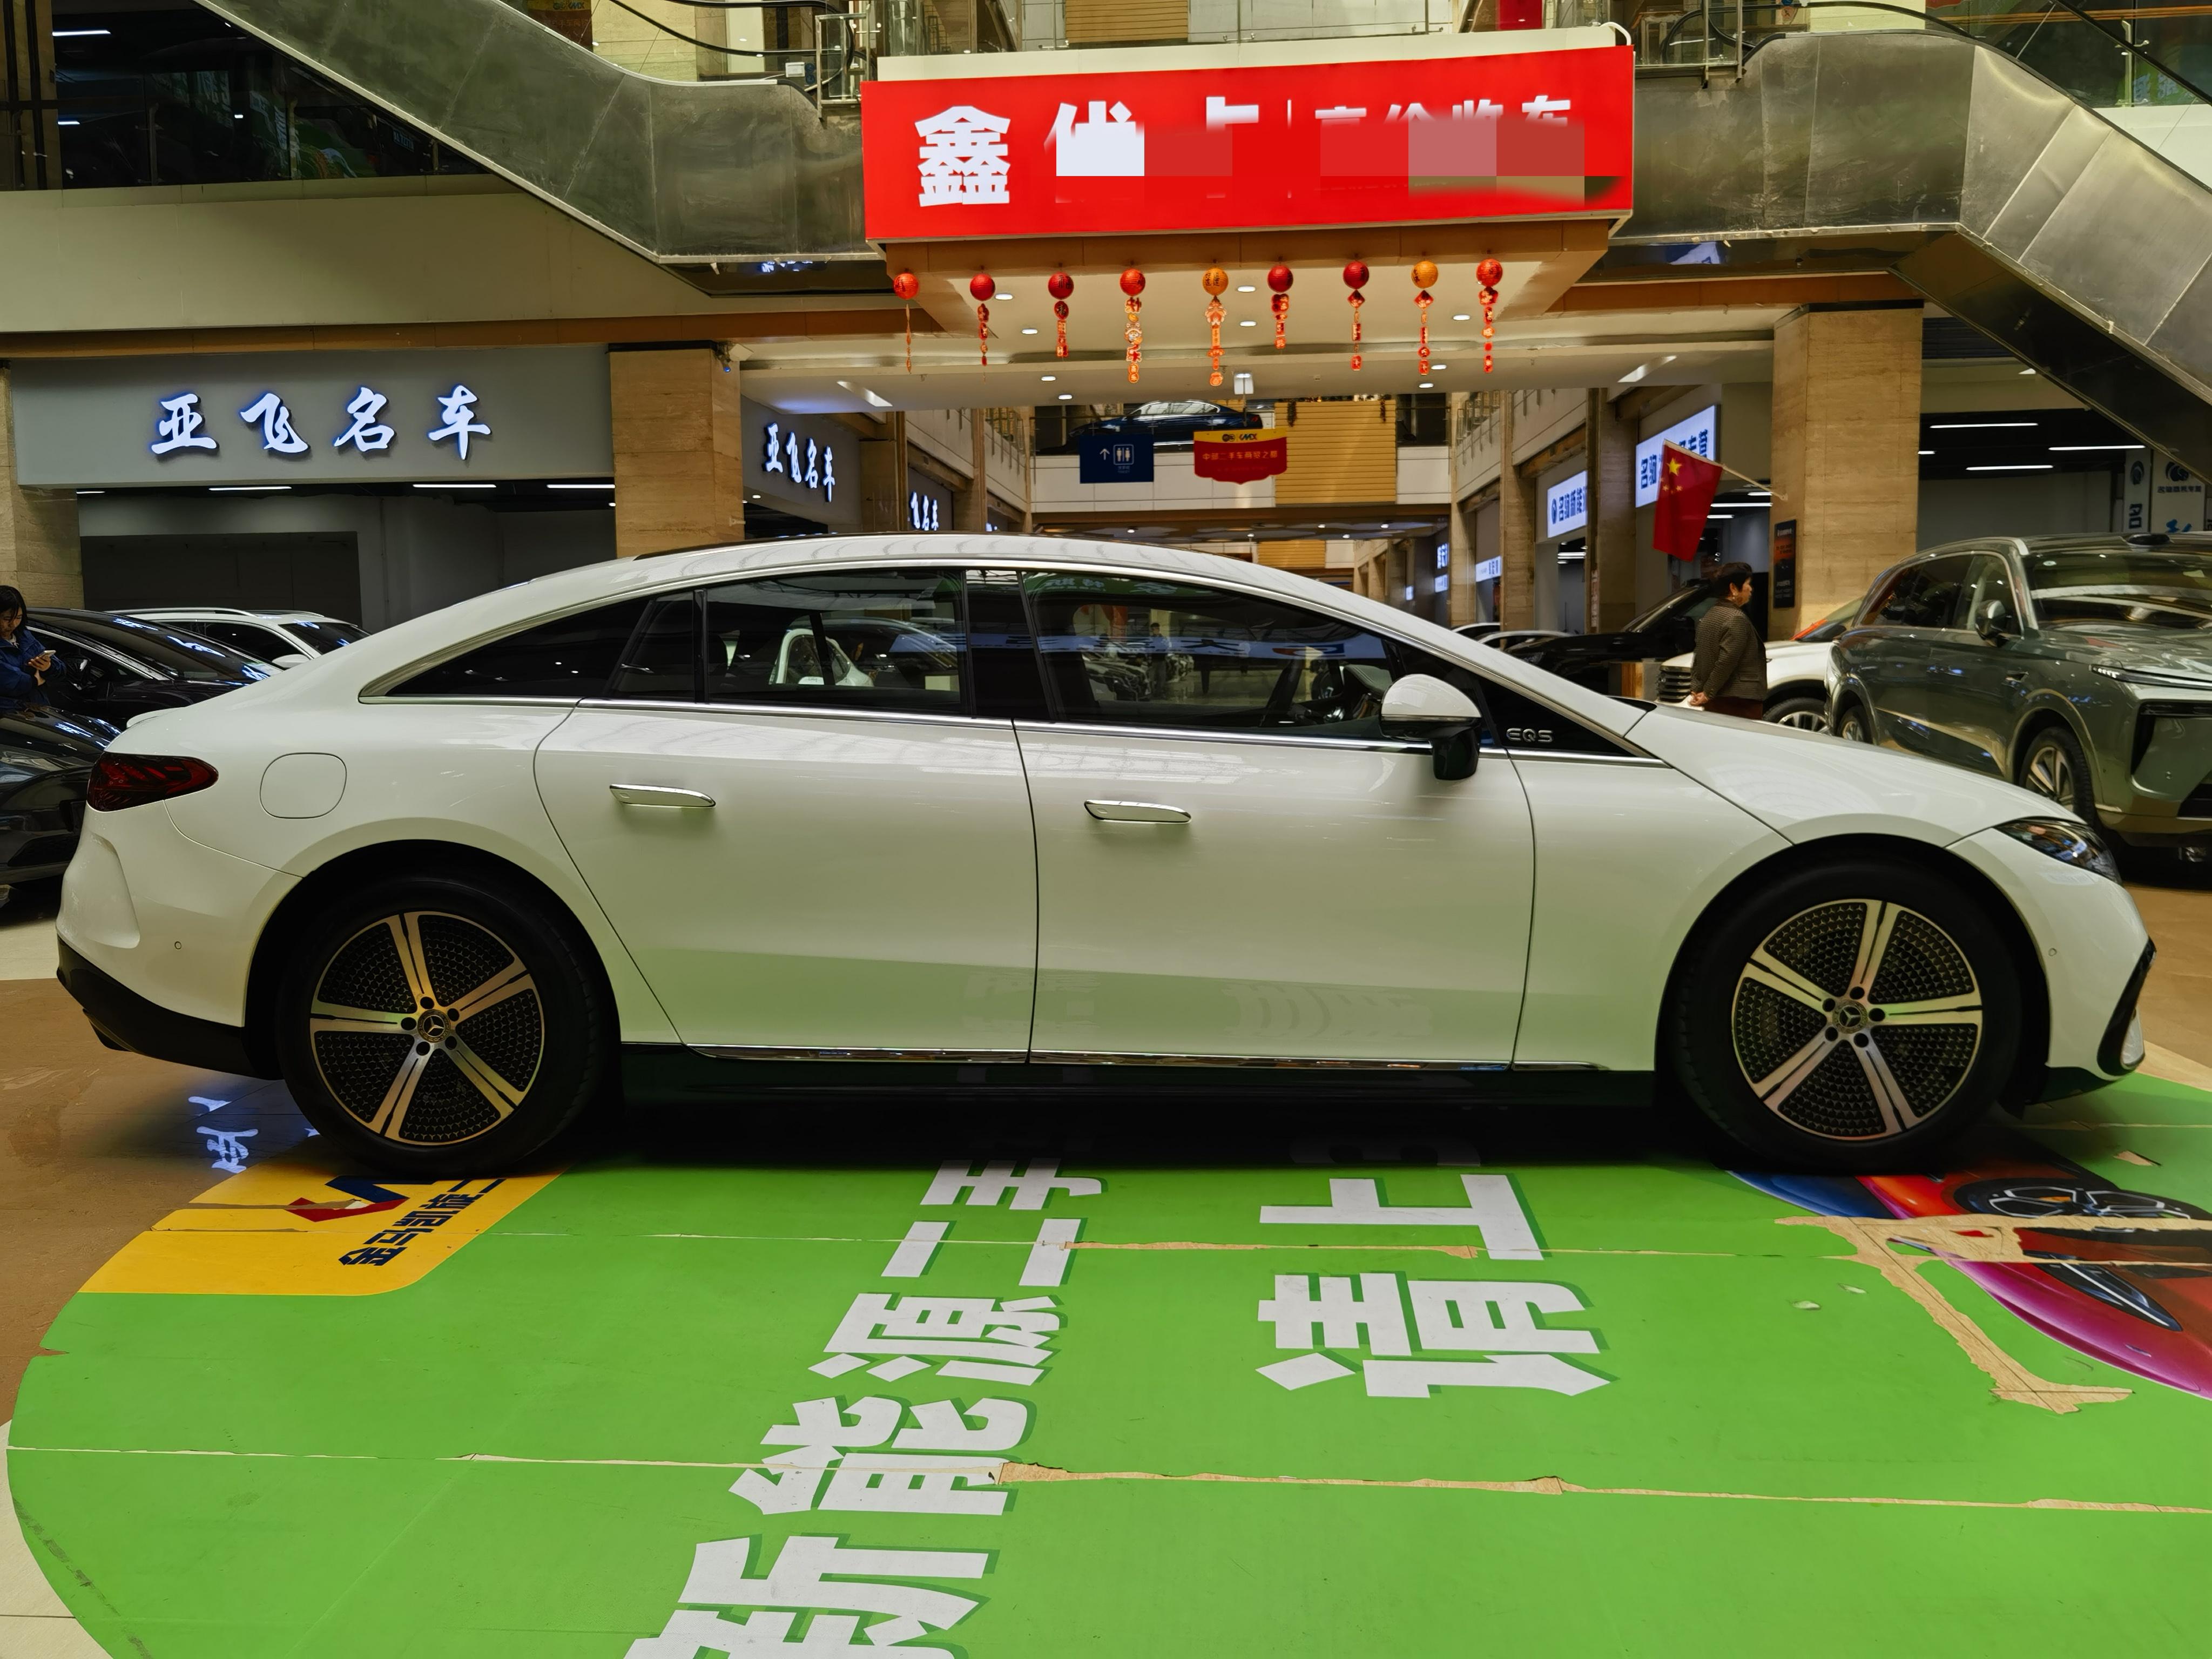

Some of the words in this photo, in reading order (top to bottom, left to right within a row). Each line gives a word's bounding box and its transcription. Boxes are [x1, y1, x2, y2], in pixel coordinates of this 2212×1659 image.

[151, 384, 491, 461] 亚飞名车
[765, 422, 835, 502] 亚飞名车
[1506, 727, 1554, 744] EQS
[1255, 1144, 1611, 1398] 请上
